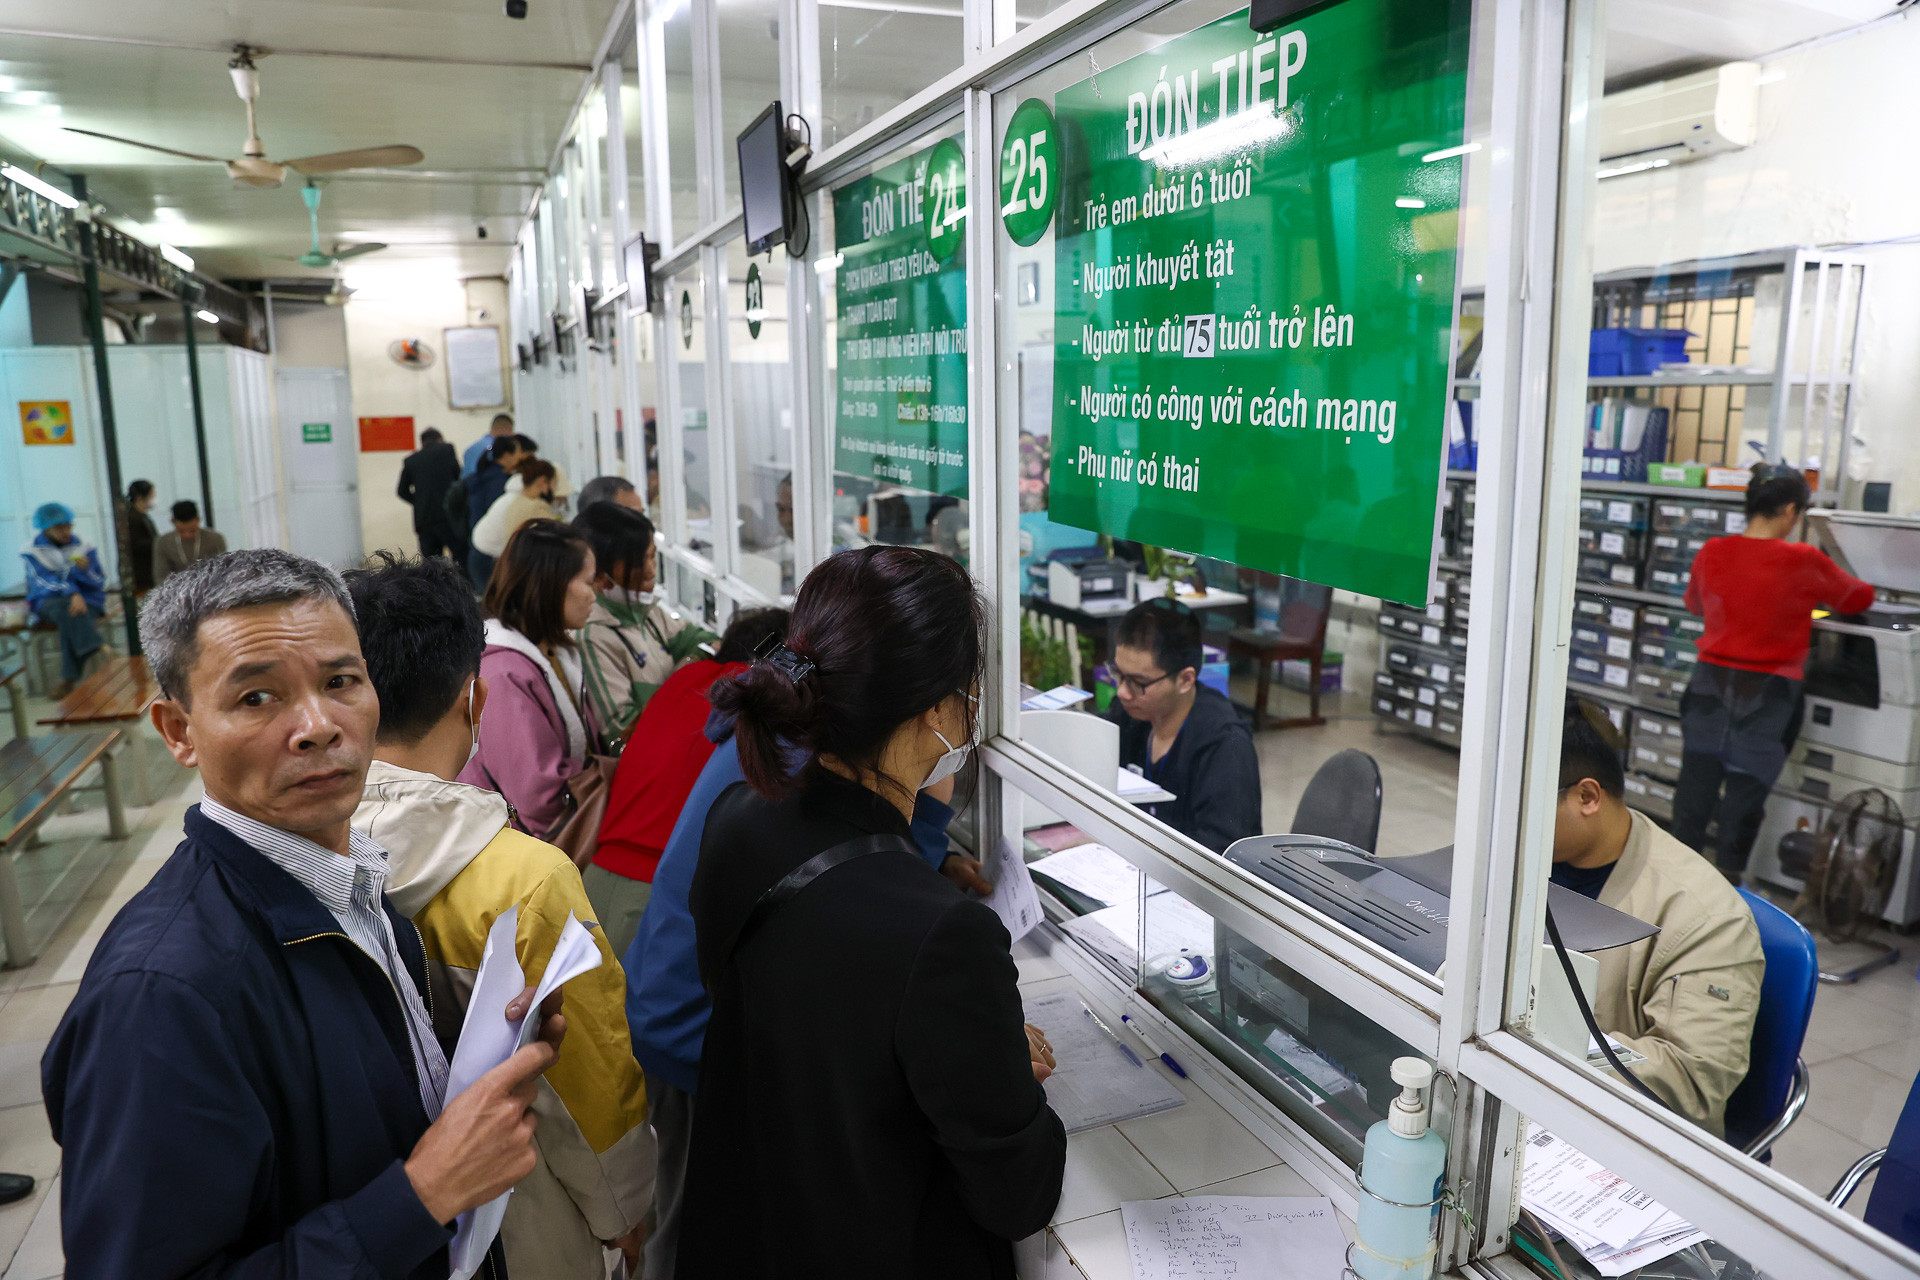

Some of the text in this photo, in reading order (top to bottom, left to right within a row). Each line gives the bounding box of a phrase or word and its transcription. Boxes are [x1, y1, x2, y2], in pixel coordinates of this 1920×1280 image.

[1126, 29, 1307, 155] ĐÓN TIẾP
[862, 160, 924, 240] ĐÓN TIẾ
[930, 163, 959, 239] 24
[1009, 129, 1048, 215] 25
[1084, 193, 1107, 230] Trẻ
[1112, 196, 1137, 225] em
[1143, 175, 1185, 218] dưới
[1191, 172, 1203, 208] 6
[1210, 152, 1251, 203] tuổi
[889, 256, 907, 282] THEO
[908, 248, 923, 278] YÊU
[1084, 256, 1131, 299] Người
[1136, 239, 1199, 290] khuyết
[1205, 239, 1234, 288] tật
[920, 326, 934, 356] PHÍ
[934, 324, 950, 362] NỘI
[1083, 320, 1129, 361] Người
[1134, 318, 1154, 353] từ
[1158, 314, 1182, 352] đủ
[1186, 319, 1210, 353] 75
[1219, 304, 1261, 350] tuổi
[1269, 304, 1307, 349] trở
[1313, 304, 1354, 348] lên
[1080, 384, 1127, 423] Người
[1131, 385, 1151, 419] có
[1157, 385, 1204, 430] công
[1210, 385, 1243, 425] với
[1250, 387, 1307, 428] cách
[1316, 398, 1397, 444] mạng
[1078, 445, 1106, 487] Phụ
[1111, 450, 1134, 482] nữ
[1137, 452, 1158, 486] có
[1163, 455, 1200, 492] thai
